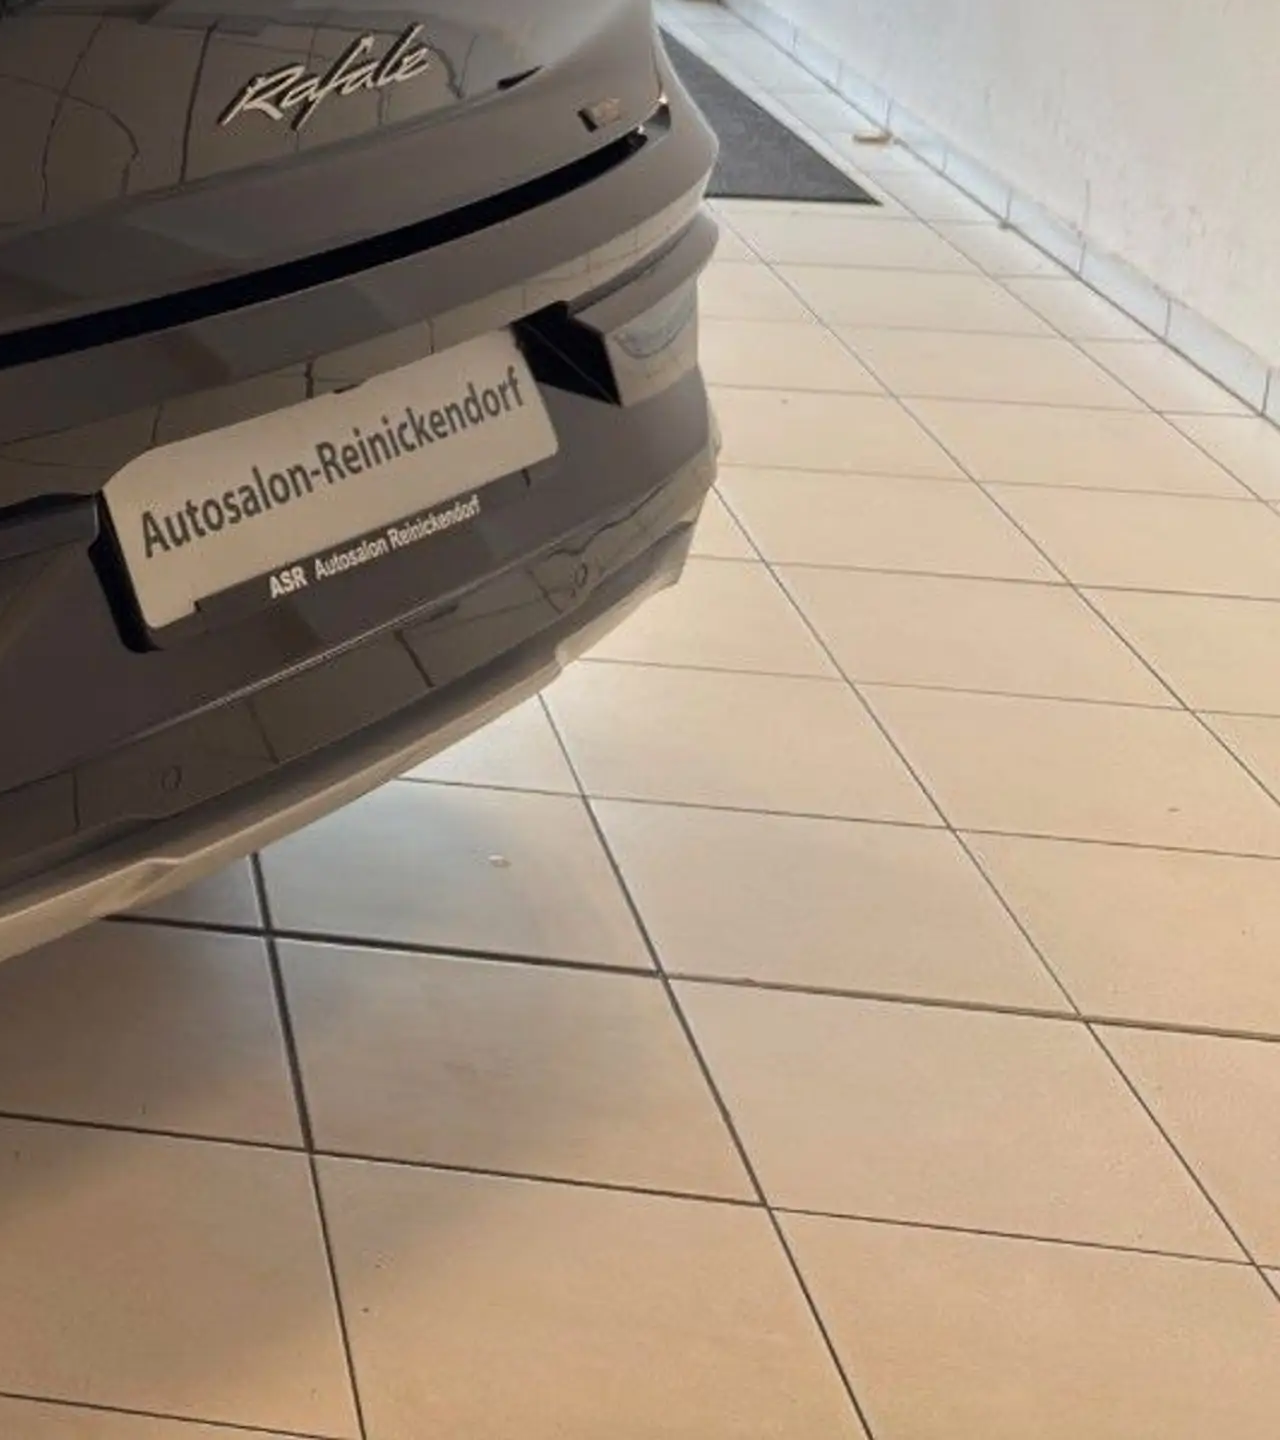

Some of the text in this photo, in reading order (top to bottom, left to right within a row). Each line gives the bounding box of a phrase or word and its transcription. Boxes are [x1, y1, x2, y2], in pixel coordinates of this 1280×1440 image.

[218, 23, 429, 129] Rafale
[141, 366, 524, 558] Autosalon-Reinickendorf
[269, 493, 481, 599] ASR Autosalon Reinickendorf
